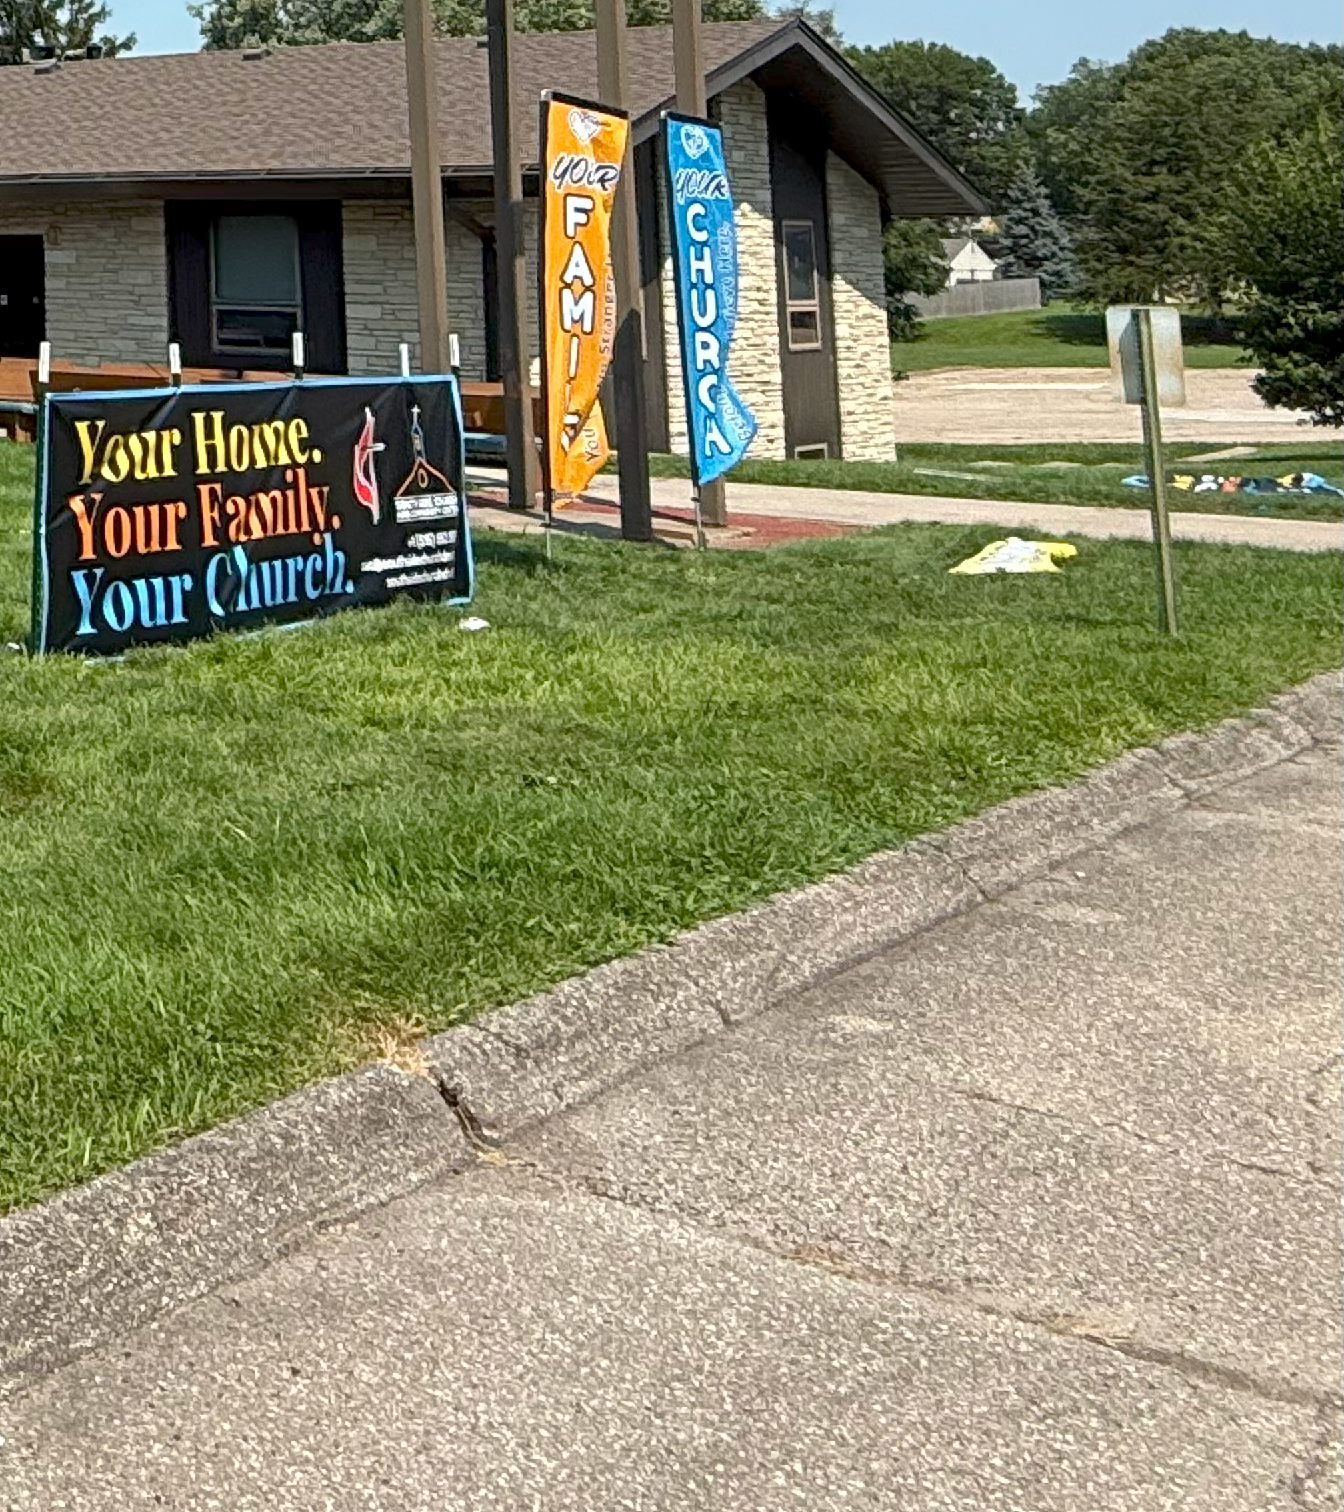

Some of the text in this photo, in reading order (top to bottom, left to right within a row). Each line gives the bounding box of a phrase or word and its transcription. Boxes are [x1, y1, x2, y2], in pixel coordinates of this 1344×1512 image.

[676, 170, 728, 202] YOUR
[74, 410, 323, 486] Your Home.
[68, 467, 342, 561] Your Family.
[70, 534, 355, 636] Your Church.
